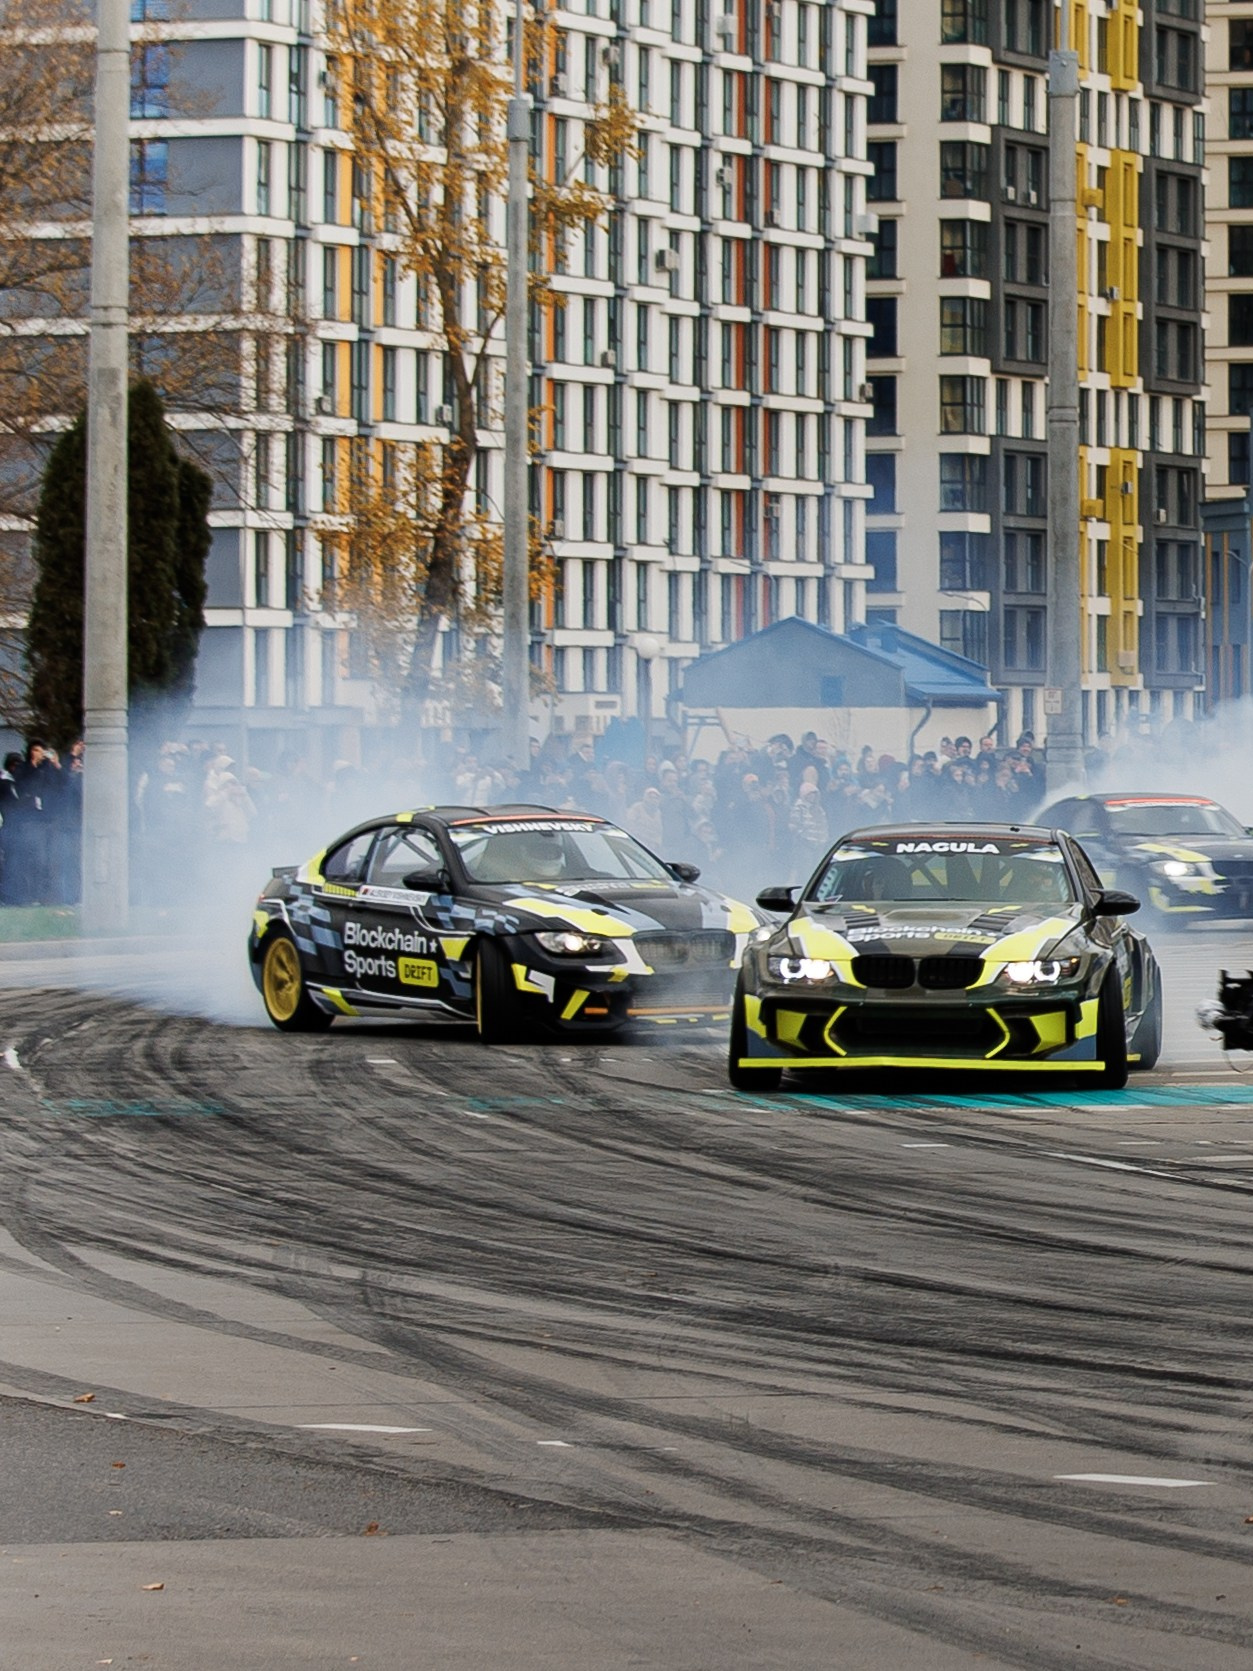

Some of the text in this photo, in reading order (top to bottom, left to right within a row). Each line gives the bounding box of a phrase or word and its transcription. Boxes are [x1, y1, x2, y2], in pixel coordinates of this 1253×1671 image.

[482, 821, 593, 834] VISHNEVSKY
[896, 842, 1000, 854] NAGULA
[344, 921, 427, 954] Blockchain
[344, 949, 433, 981] Sports DRIFT
